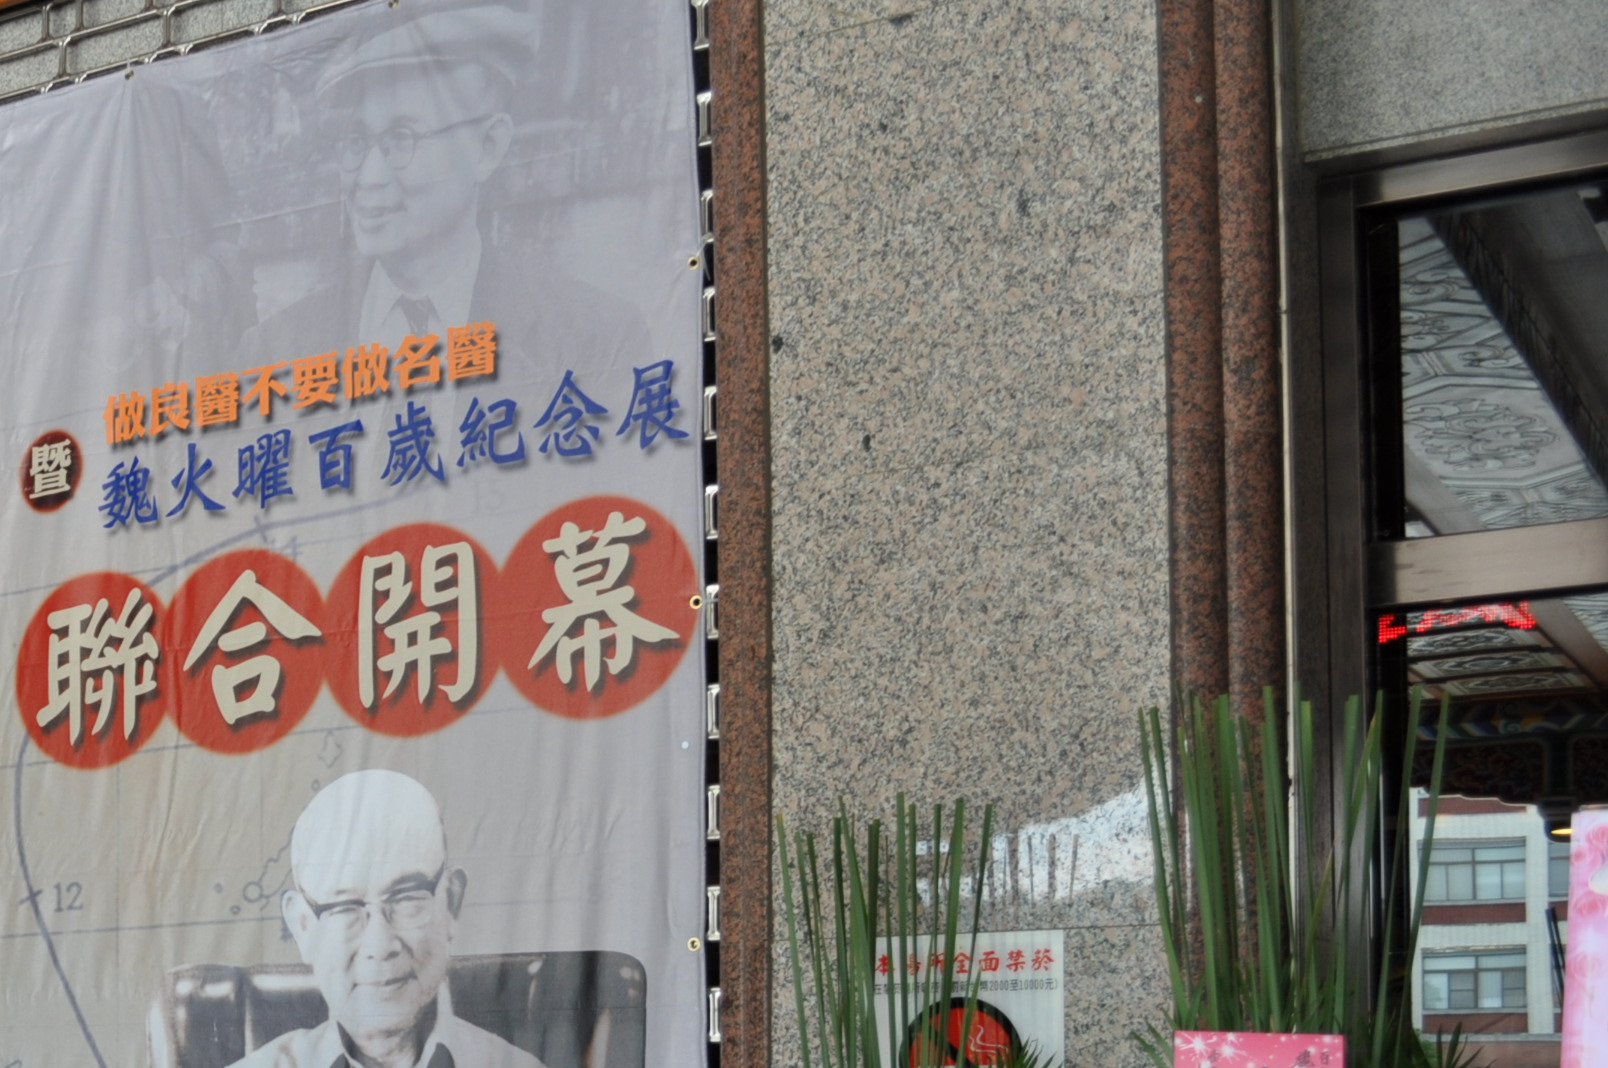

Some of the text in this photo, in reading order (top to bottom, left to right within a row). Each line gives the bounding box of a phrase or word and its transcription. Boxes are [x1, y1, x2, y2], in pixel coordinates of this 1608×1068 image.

[98, 359, 690, 529] 魏火曜百歲紀念展
[102, 320, 497, 445] 做良醫不要做名醫
[29, 438, 72, 501] 暨
[35, 511, 681, 747] 聯合開幕
[53, 882, 84, 912] 12
